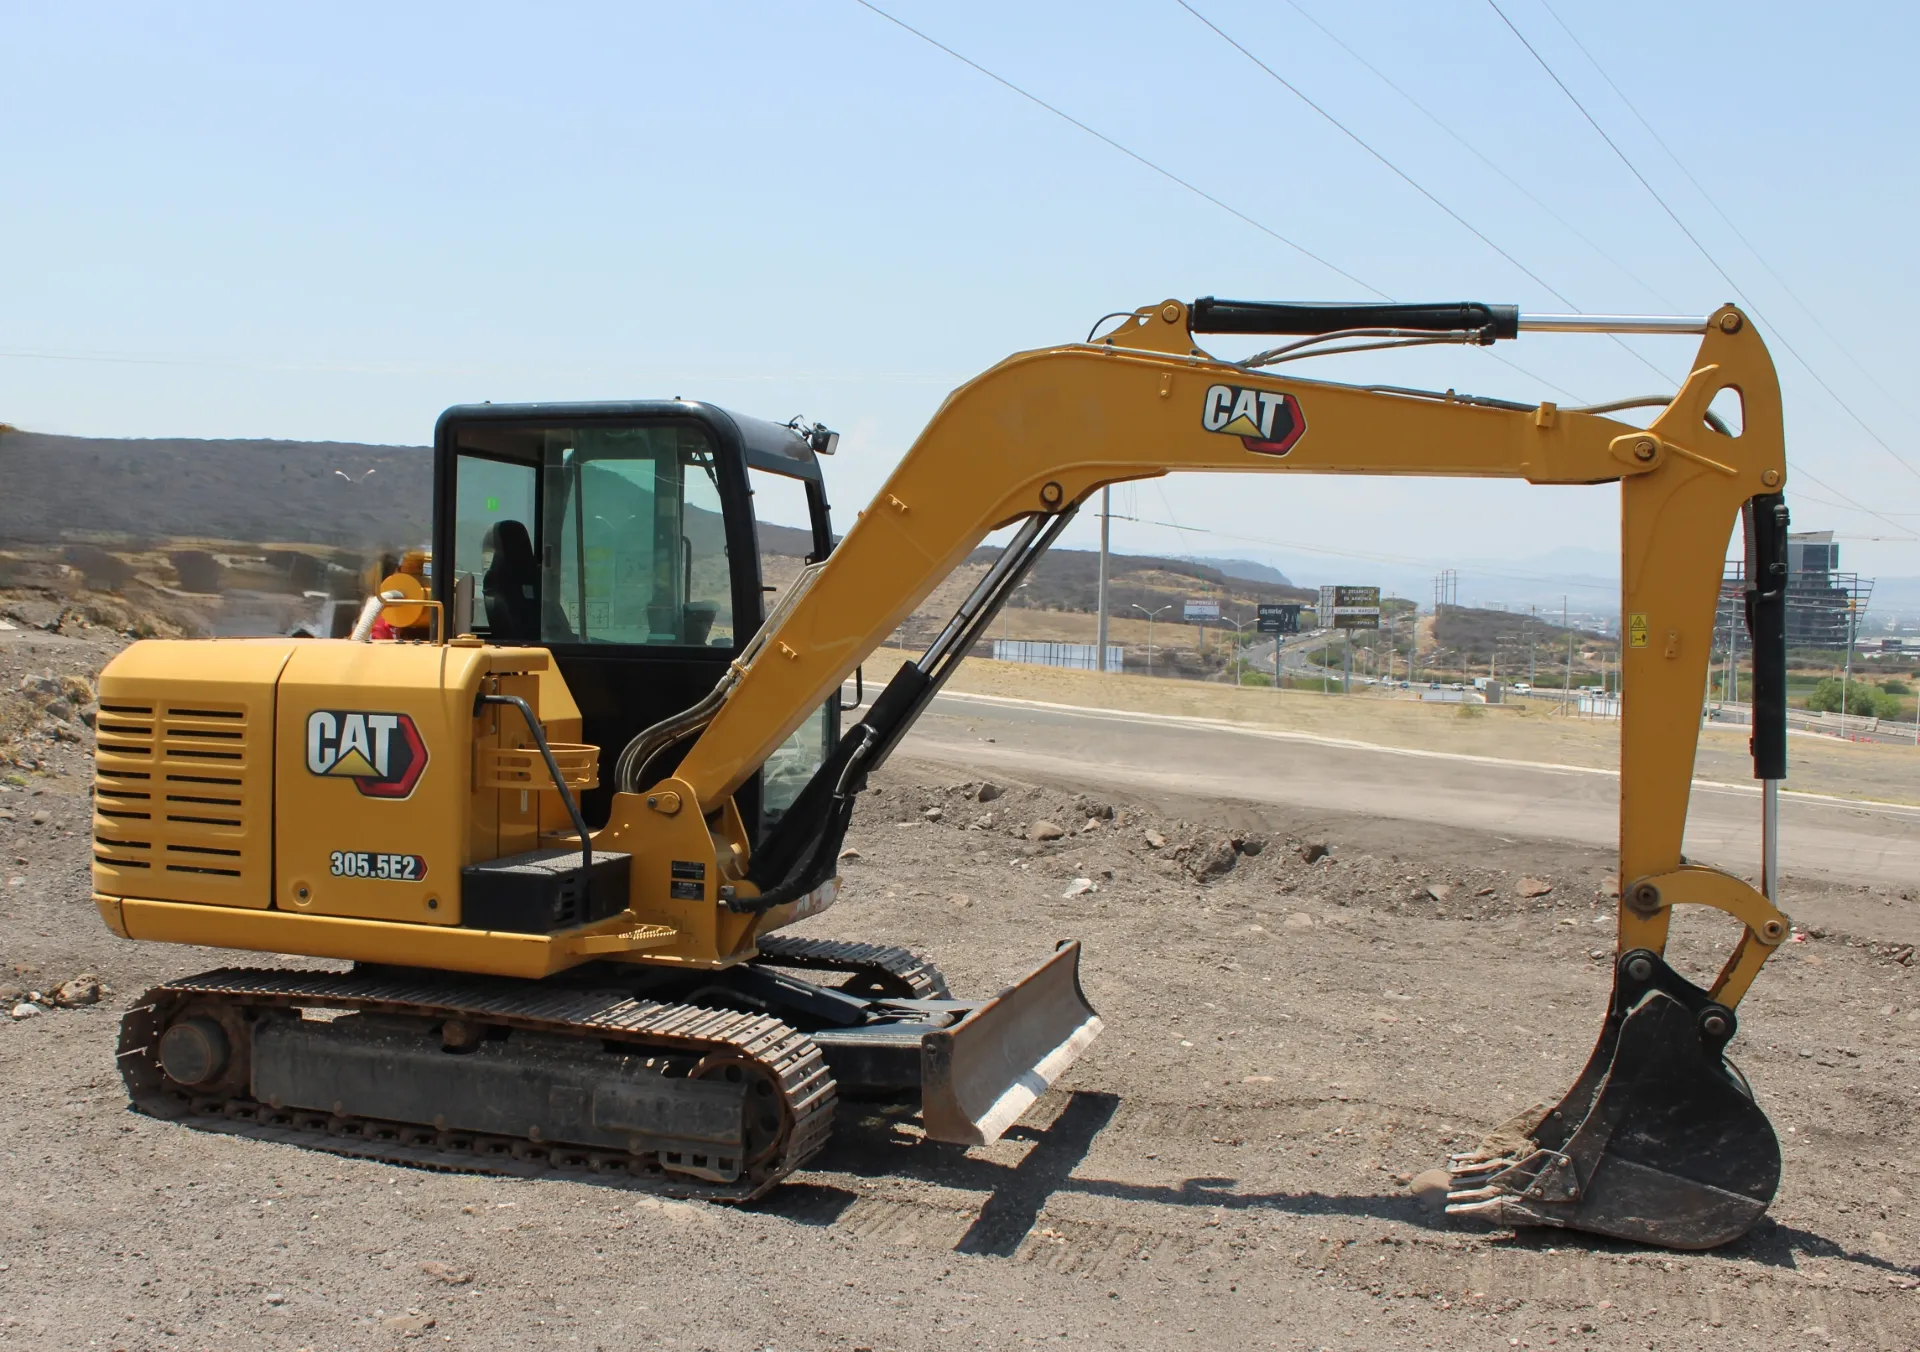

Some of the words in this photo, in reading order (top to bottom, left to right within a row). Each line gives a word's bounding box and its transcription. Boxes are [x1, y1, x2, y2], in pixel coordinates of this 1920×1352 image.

[1203, 385, 1284, 439] CAT
[308, 711, 398, 777] CAT
[331, 852, 415, 879] 305.5E2
